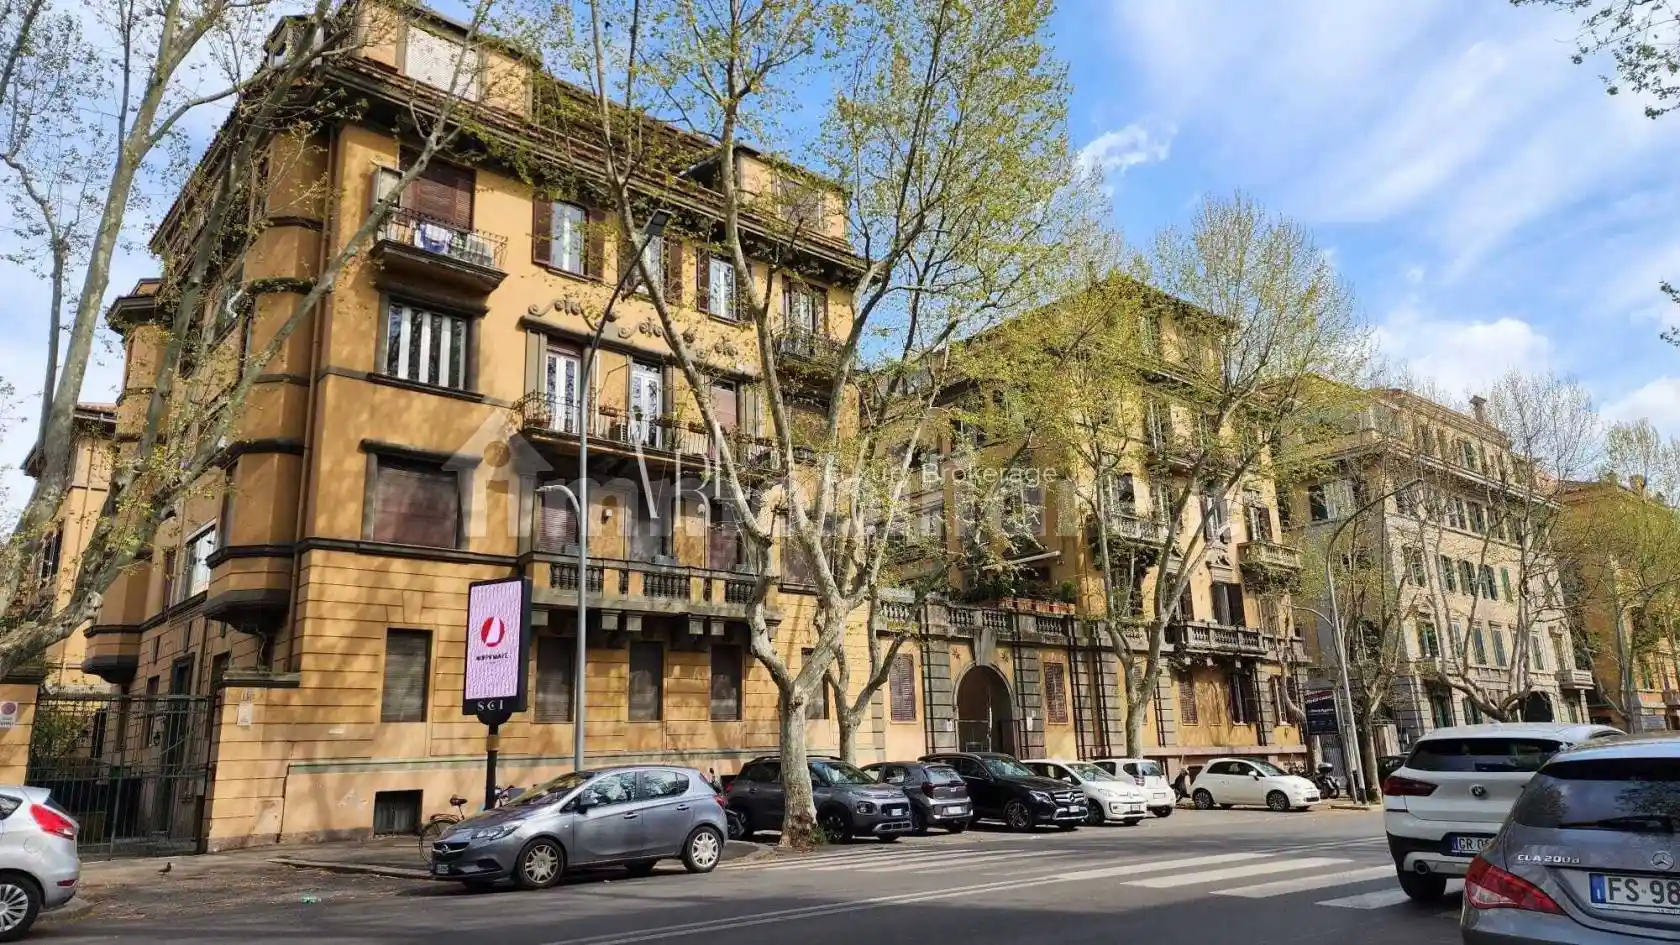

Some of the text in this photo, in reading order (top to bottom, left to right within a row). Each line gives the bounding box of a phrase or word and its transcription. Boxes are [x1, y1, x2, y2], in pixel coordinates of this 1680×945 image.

[1460, 838, 1473, 850] GR
[1518, 854, 1541, 862] CLA
[1608, 877, 1640, 902] FS
